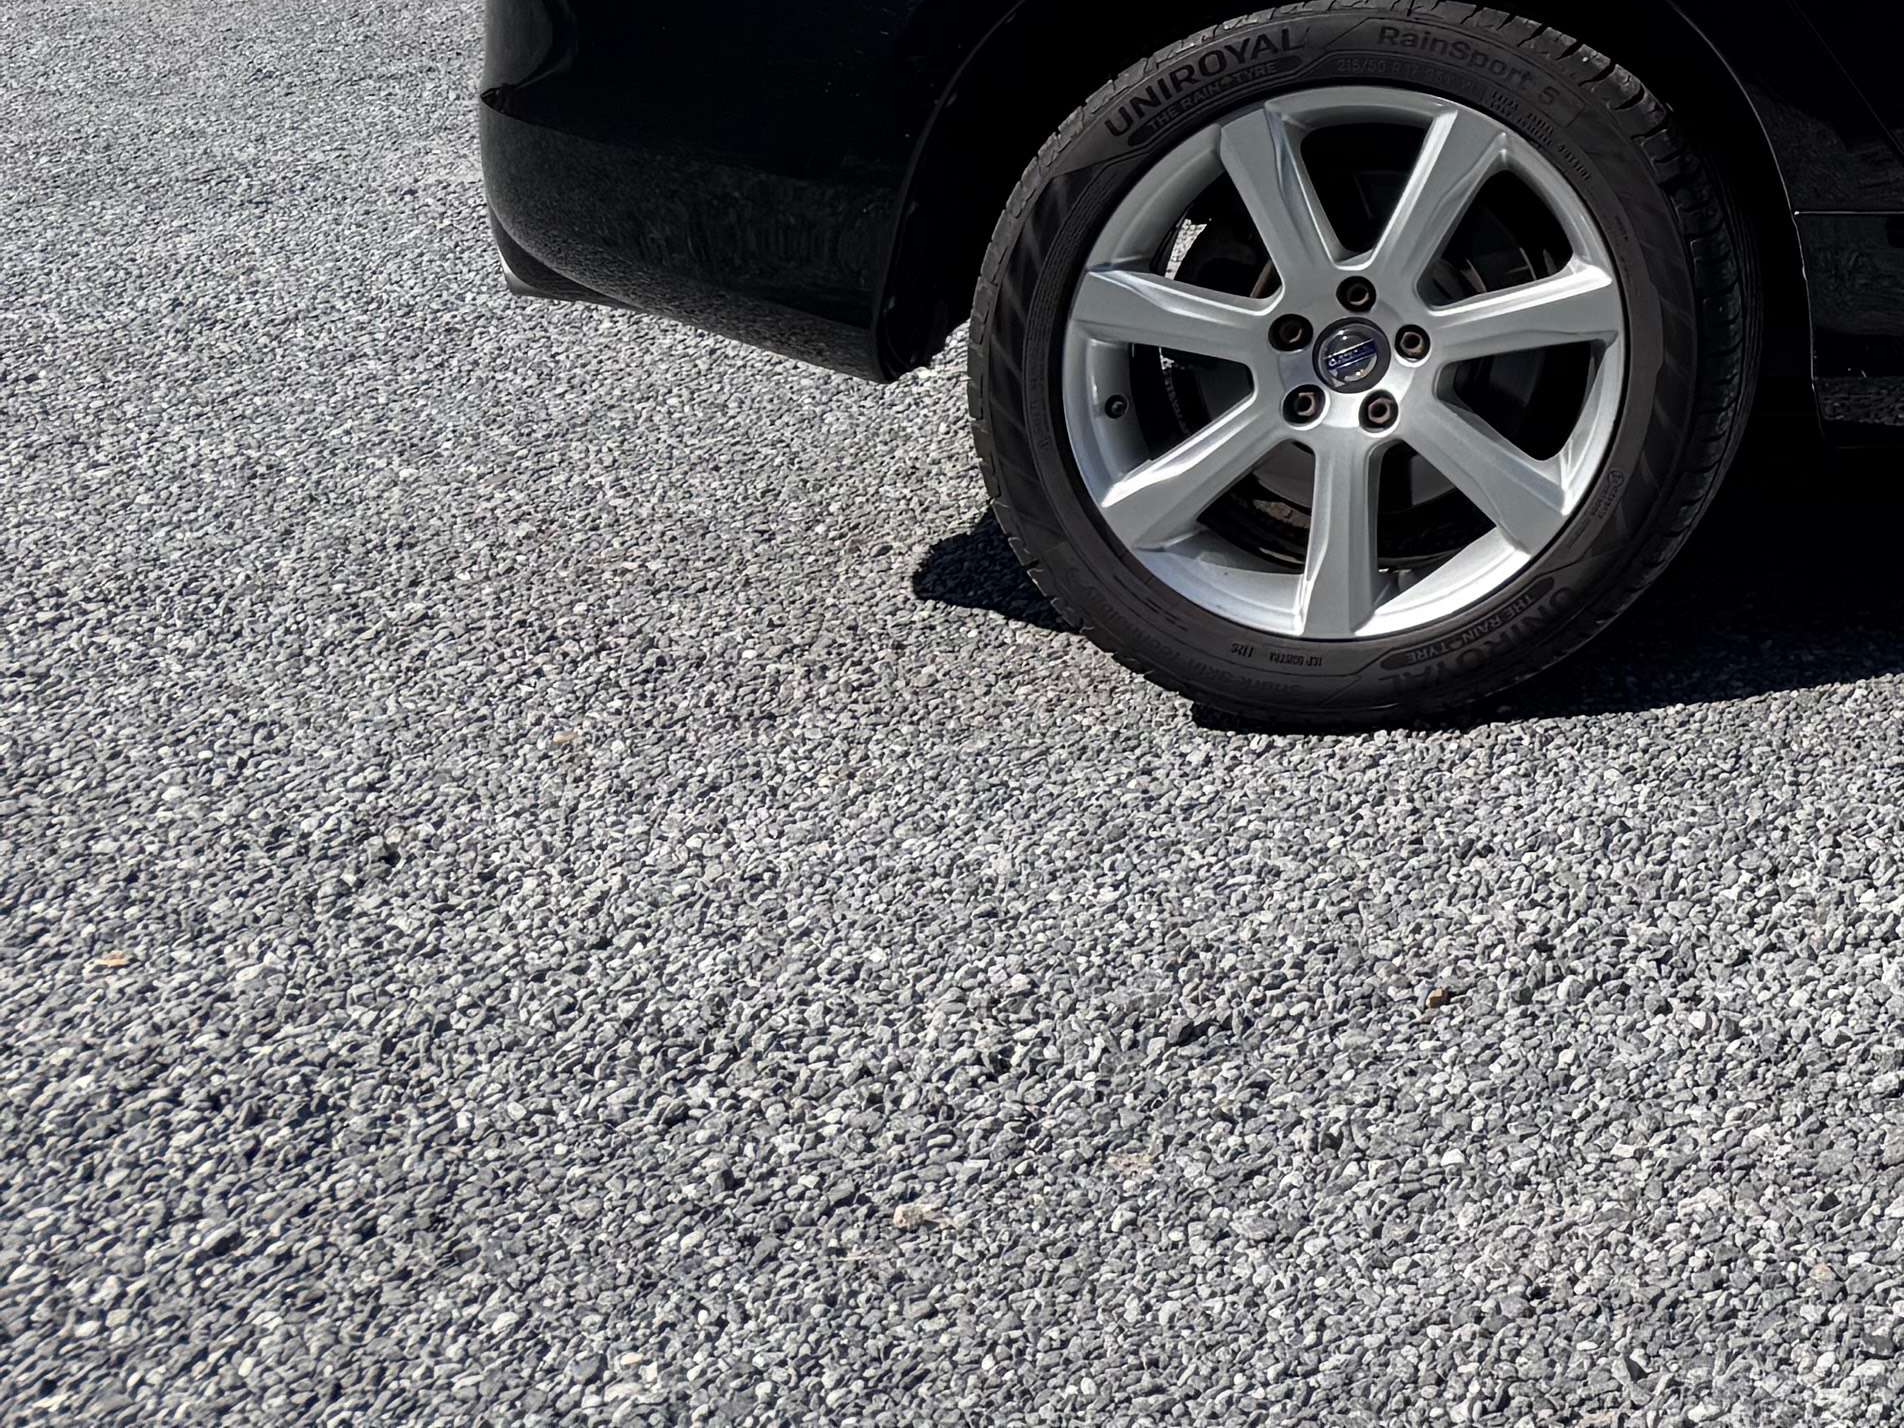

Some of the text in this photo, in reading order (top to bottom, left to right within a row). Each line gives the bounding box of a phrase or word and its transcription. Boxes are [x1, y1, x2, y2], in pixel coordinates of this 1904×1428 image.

[1103, 27, 1304, 137] UNIROYAL
[1149, 107, 1176, 132] THE
[1232, 61, 1278, 83] TYRE
